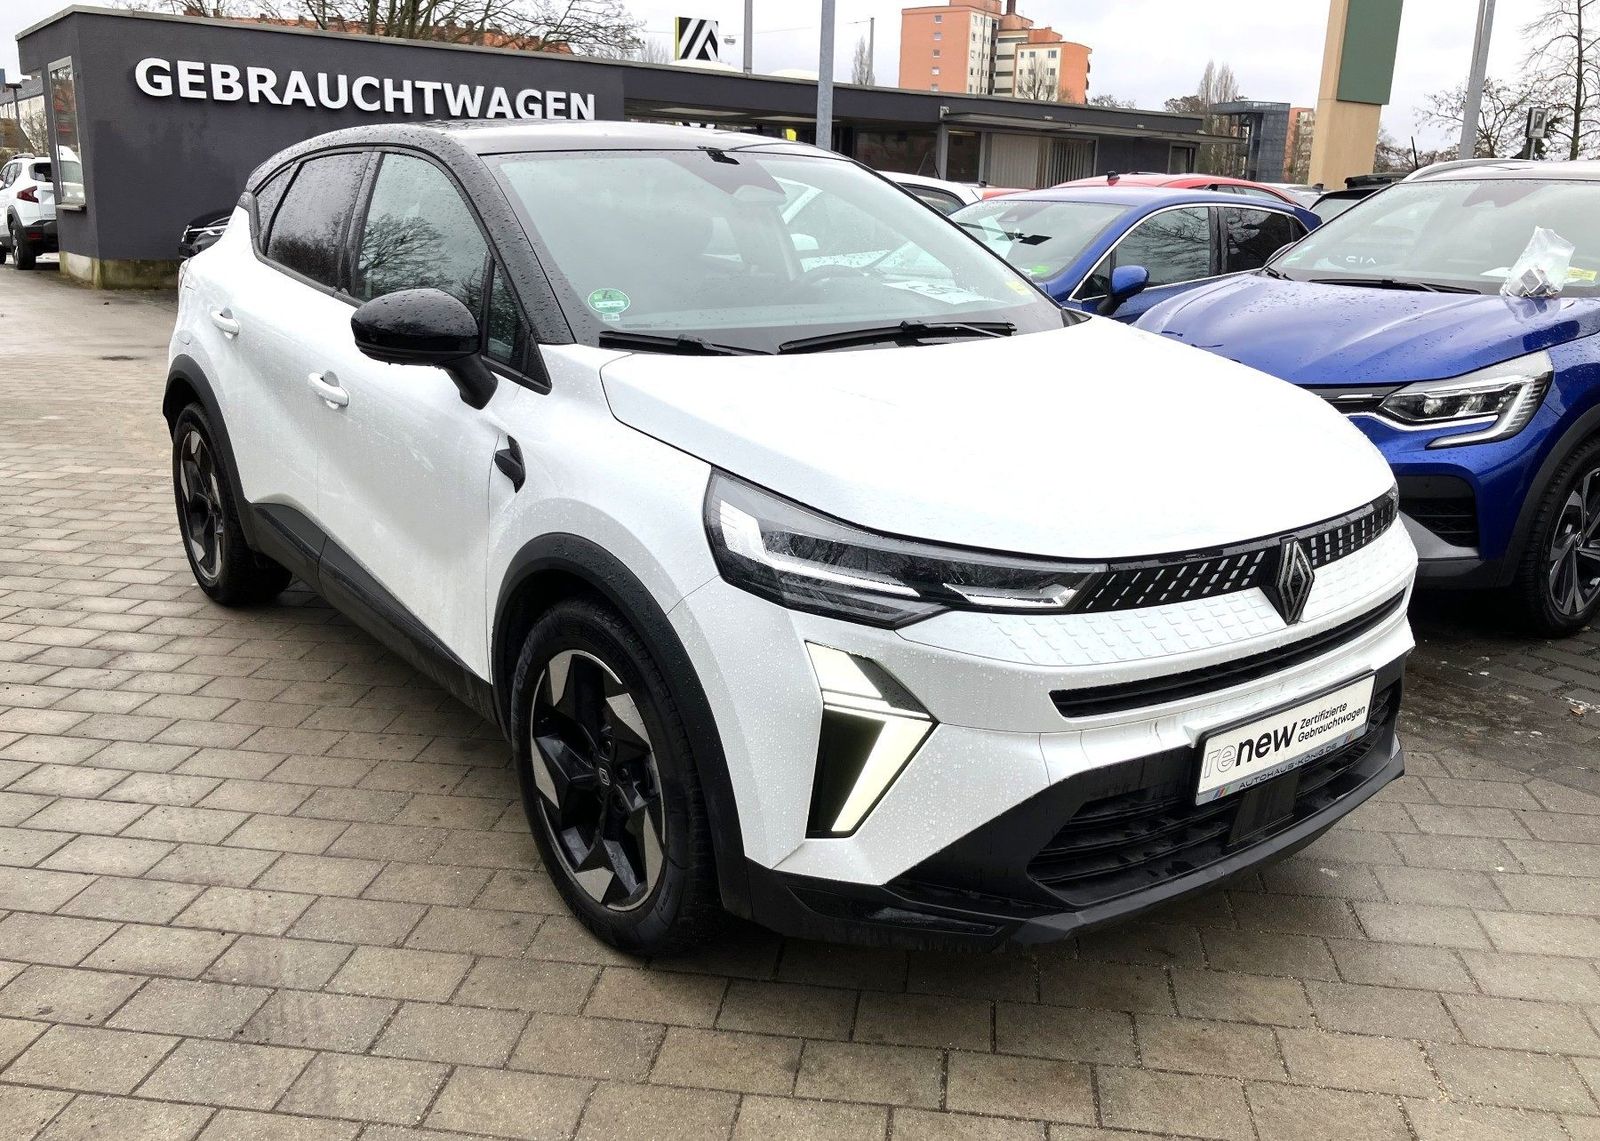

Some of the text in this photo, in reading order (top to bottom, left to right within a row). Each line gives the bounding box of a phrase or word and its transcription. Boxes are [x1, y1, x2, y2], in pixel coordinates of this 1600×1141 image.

[135, 56, 596, 121] GEBRAUCHTWAGEN
[1298, 706, 1366, 743] Gebrauchtwagen
[1299, 702, 1348, 730] Zertifizierte
[1203, 722, 1298, 779] renew
